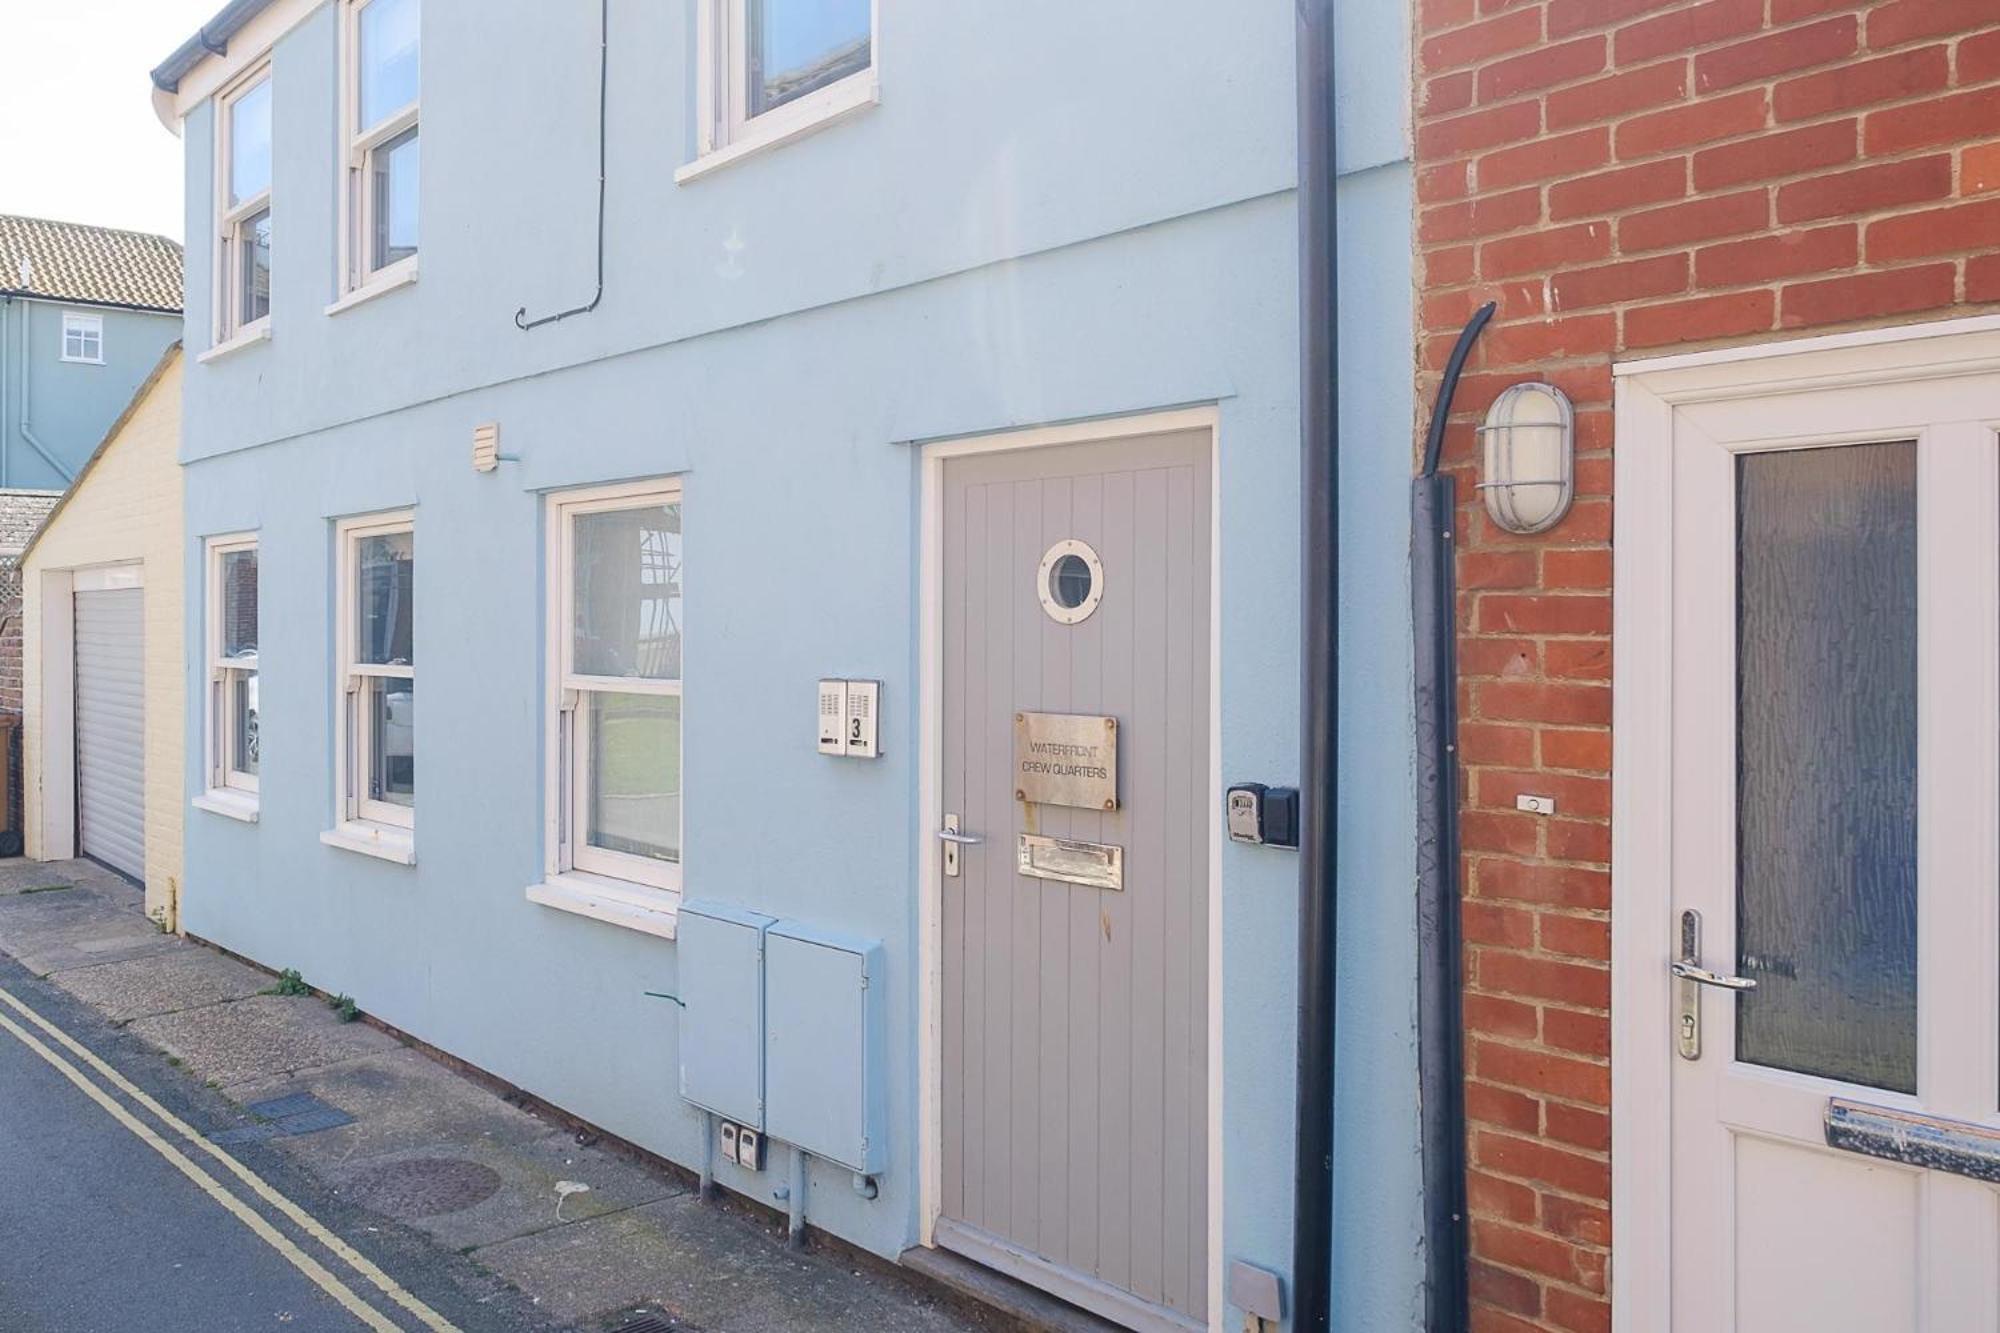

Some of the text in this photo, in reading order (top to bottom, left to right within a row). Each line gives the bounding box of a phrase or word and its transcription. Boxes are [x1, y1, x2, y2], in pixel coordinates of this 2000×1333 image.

[852, 718, 860, 738] 3
[1029, 741, 1098, 757] WATERFRONT
[1022, 760, 1107, 779] CREW QUARTERS
